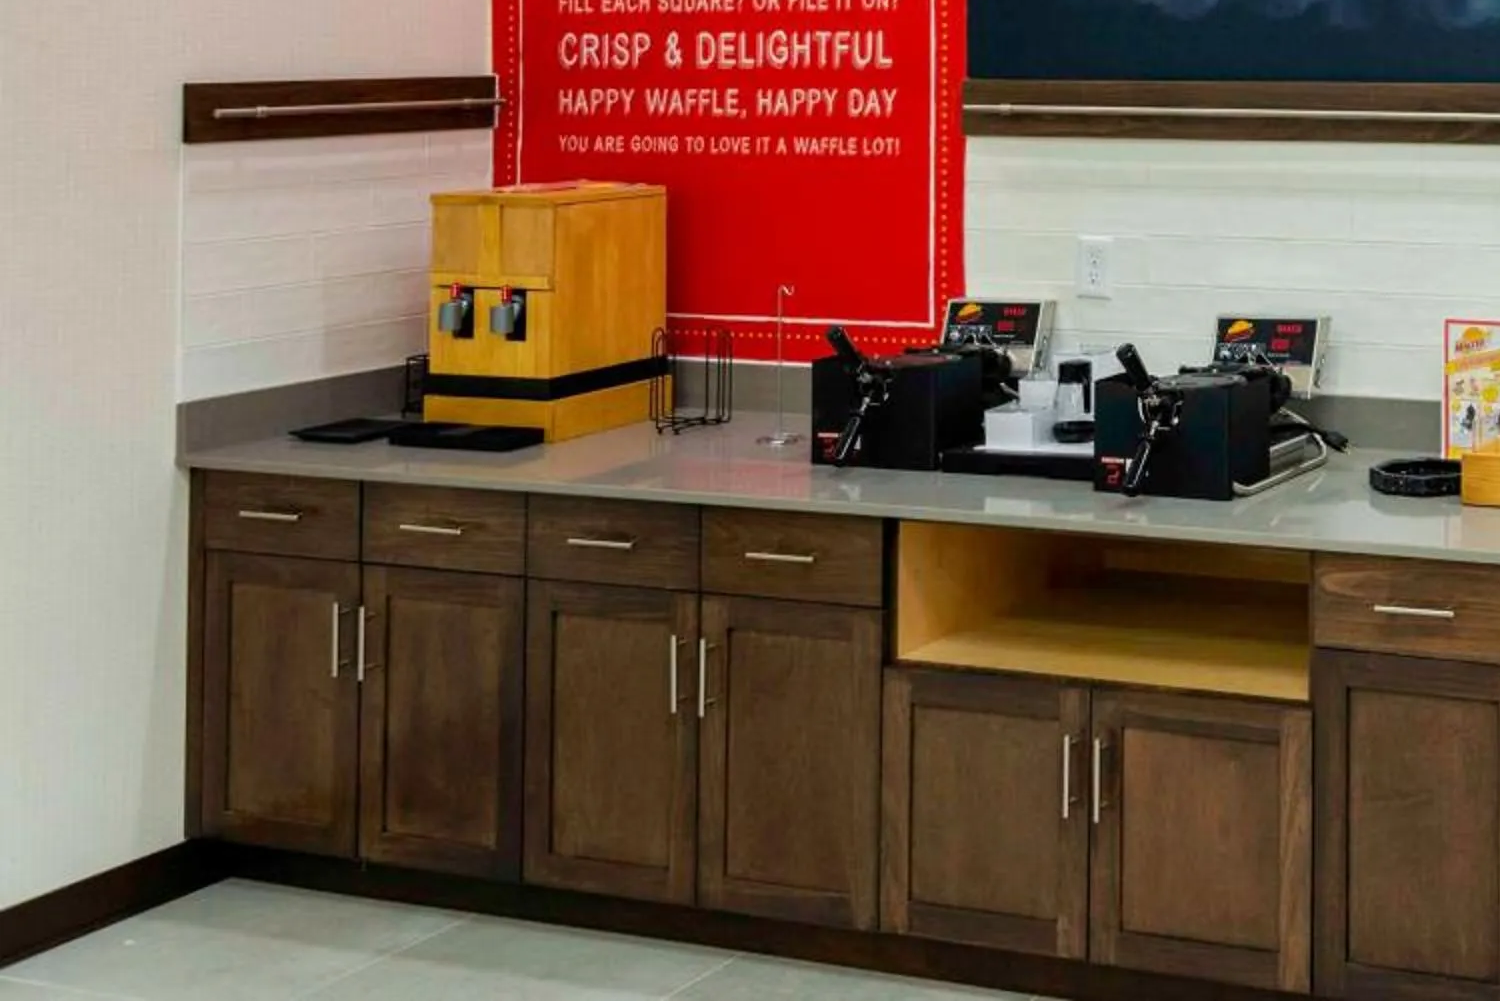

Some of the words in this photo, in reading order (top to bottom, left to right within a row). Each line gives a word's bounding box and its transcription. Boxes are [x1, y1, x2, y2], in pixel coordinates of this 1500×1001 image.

[558, 31, 651, 69] CRISP
[664, 31, 683, 68] &
[695, 30, 893, 69] DELIGHTFUL
[558, 88, 633, 117] HAPPY
[645, 88, 748, 119] WAFFLE,
[756, 88, 839, 117] HAPPY
[848, 88, 897, 117] DAY
[558, 135, 589, 153] YOU
[593, 135, 625, 153] ARE
[630, 135, 679, 154] GOING
[686, 136, 706, 153] TO
[709, 136, 751, 155] LOVE
[755, 136, 771, 154] IT
[776, 137, 788, 155] A
[793, 137, 859, 156] WAFFLE
[862, 137, 901, 157] LOT!
